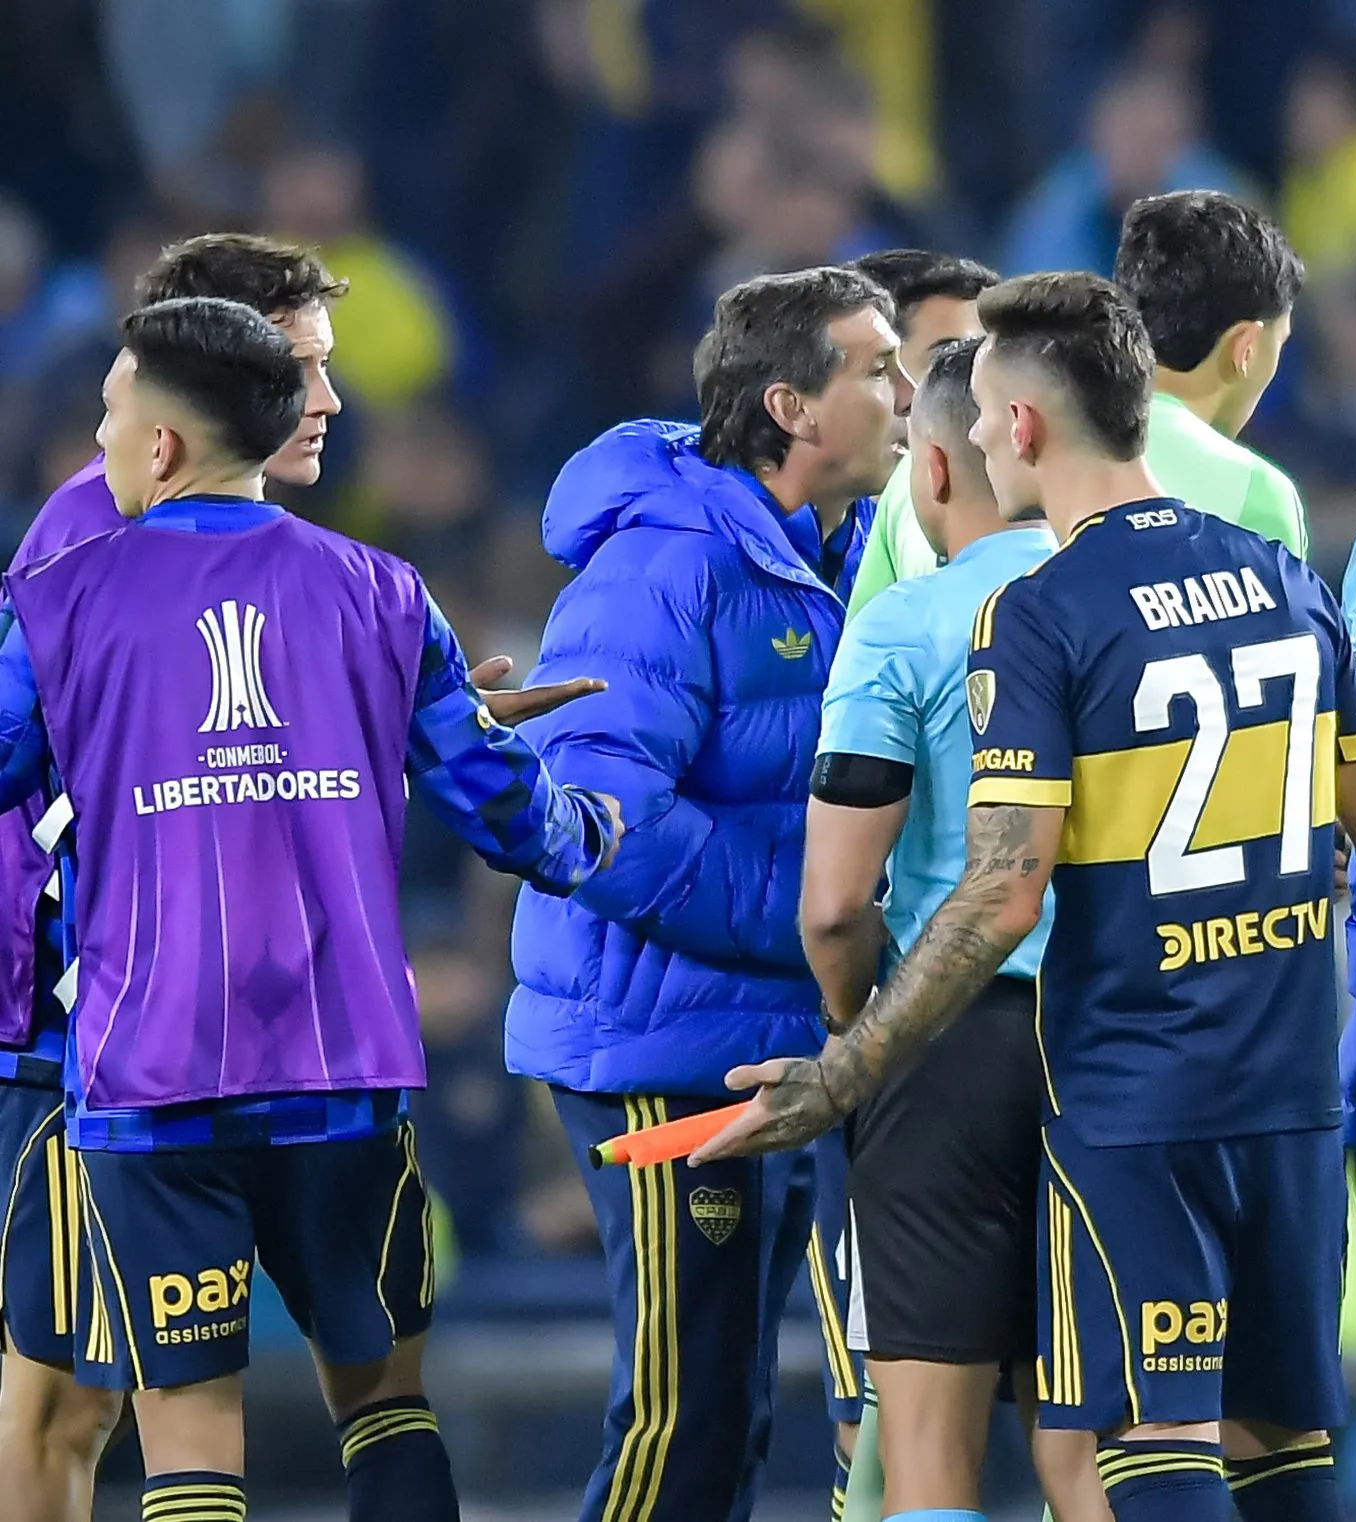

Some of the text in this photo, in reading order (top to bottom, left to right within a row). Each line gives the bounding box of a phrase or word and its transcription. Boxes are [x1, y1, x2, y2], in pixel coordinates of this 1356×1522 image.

[1125, 509, 1178, 530] 1905
[1130, 566, 1277, 631] BRAIDA
[133, 769, 361, 816] LIBERTADORES
[1133, 633, 1320, 896] 27
[1156, 898, 1329, 972] DIRECTV
[149, 1259, 250, 1328] pax
